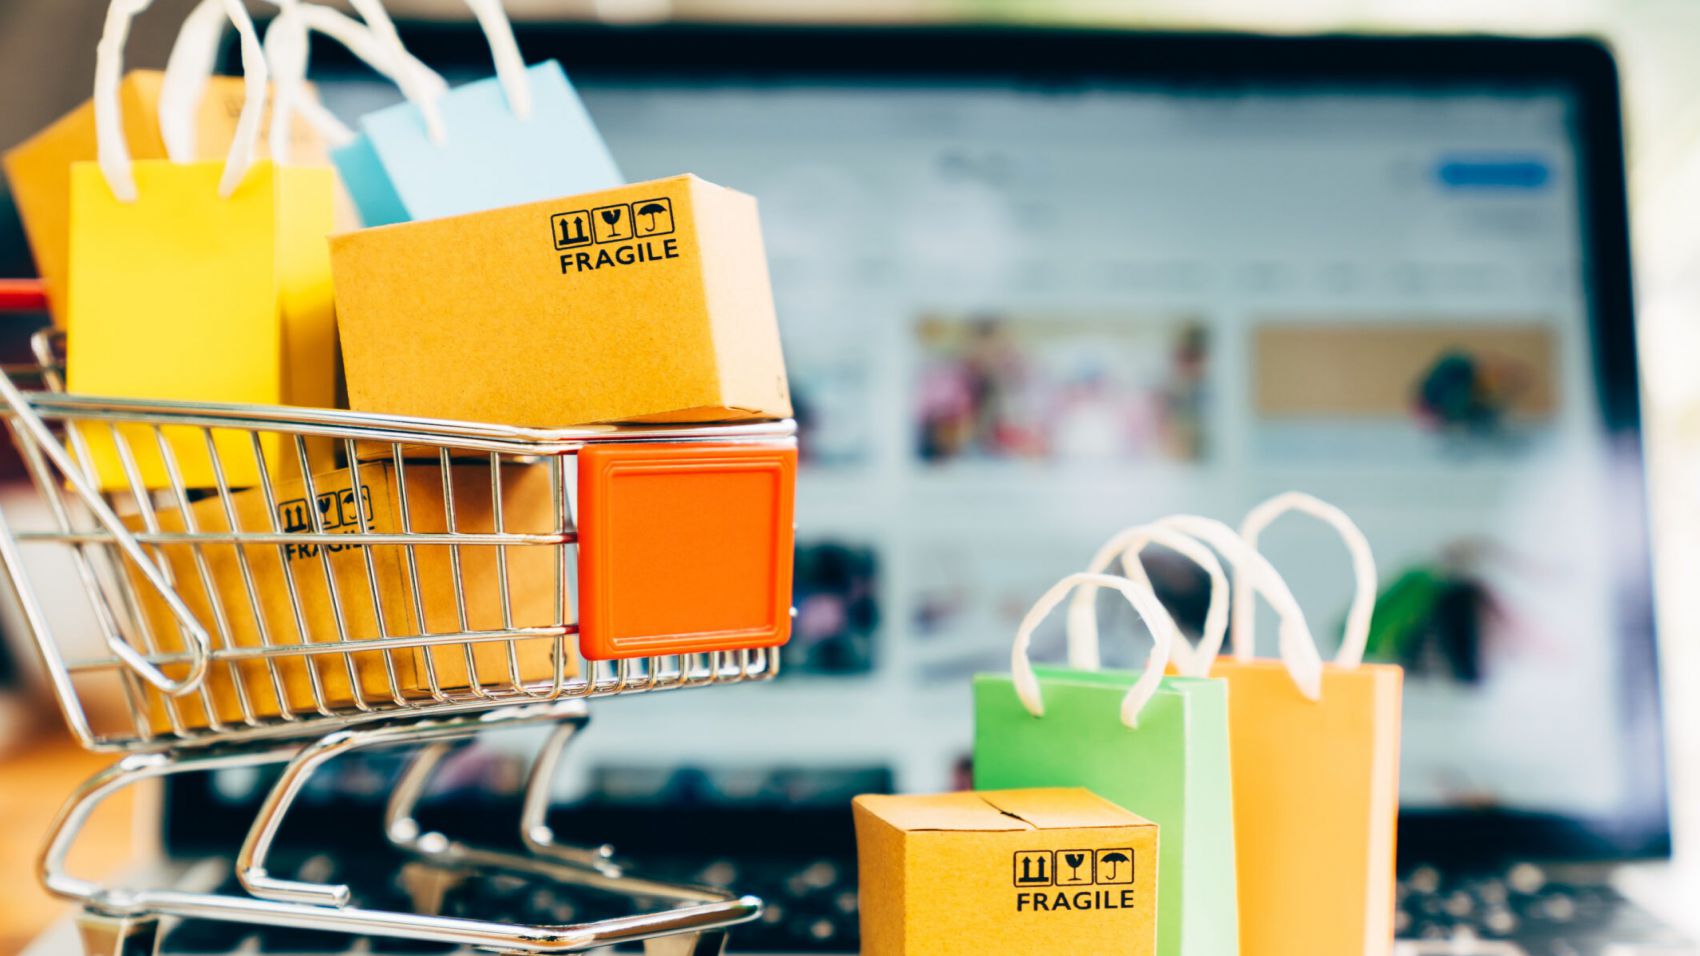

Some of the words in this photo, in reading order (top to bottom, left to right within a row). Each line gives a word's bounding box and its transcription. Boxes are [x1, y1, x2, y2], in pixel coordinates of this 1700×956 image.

[560, 238, 679, 274] FRAGILE
[284, 526, 375, 561] FRGL
[1017, 889, 1134, 911] FRAGILE
